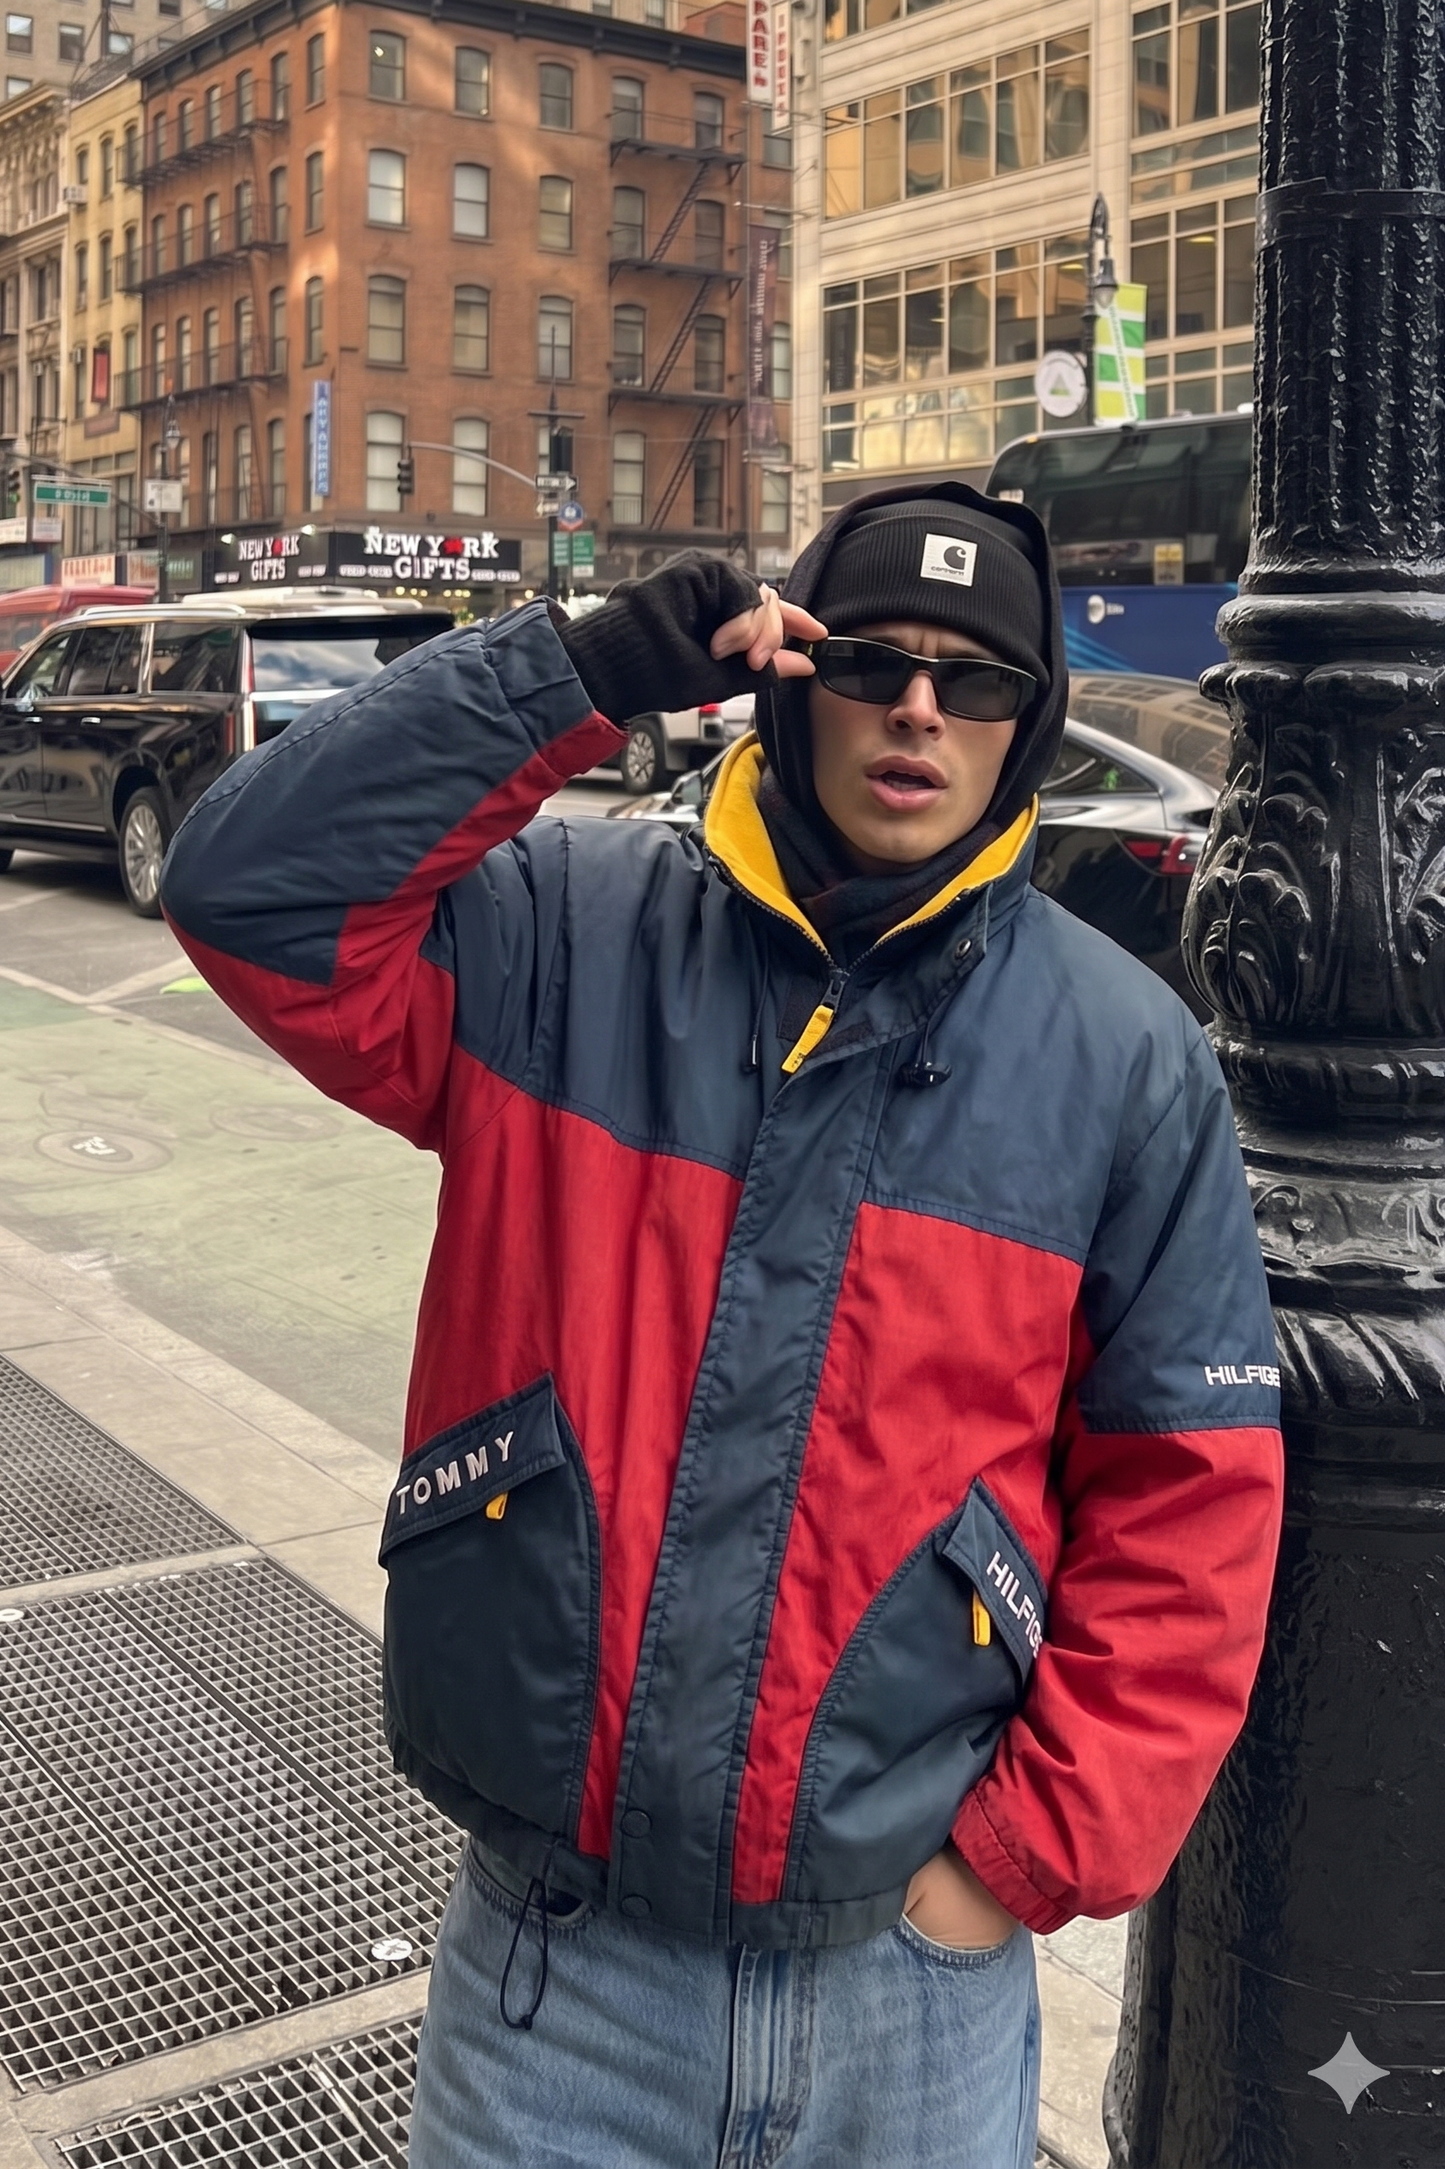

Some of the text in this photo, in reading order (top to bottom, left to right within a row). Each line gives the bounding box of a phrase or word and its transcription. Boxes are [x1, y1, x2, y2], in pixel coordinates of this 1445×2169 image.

[238, 539, 264, 561] NEW
[364, 531, 421, 556] NEW
[250, 558, 286, 581] GIFTS
[394, 556, 471, 580] GIFTS
[396, 1431, 514, 1515] TOMMY
